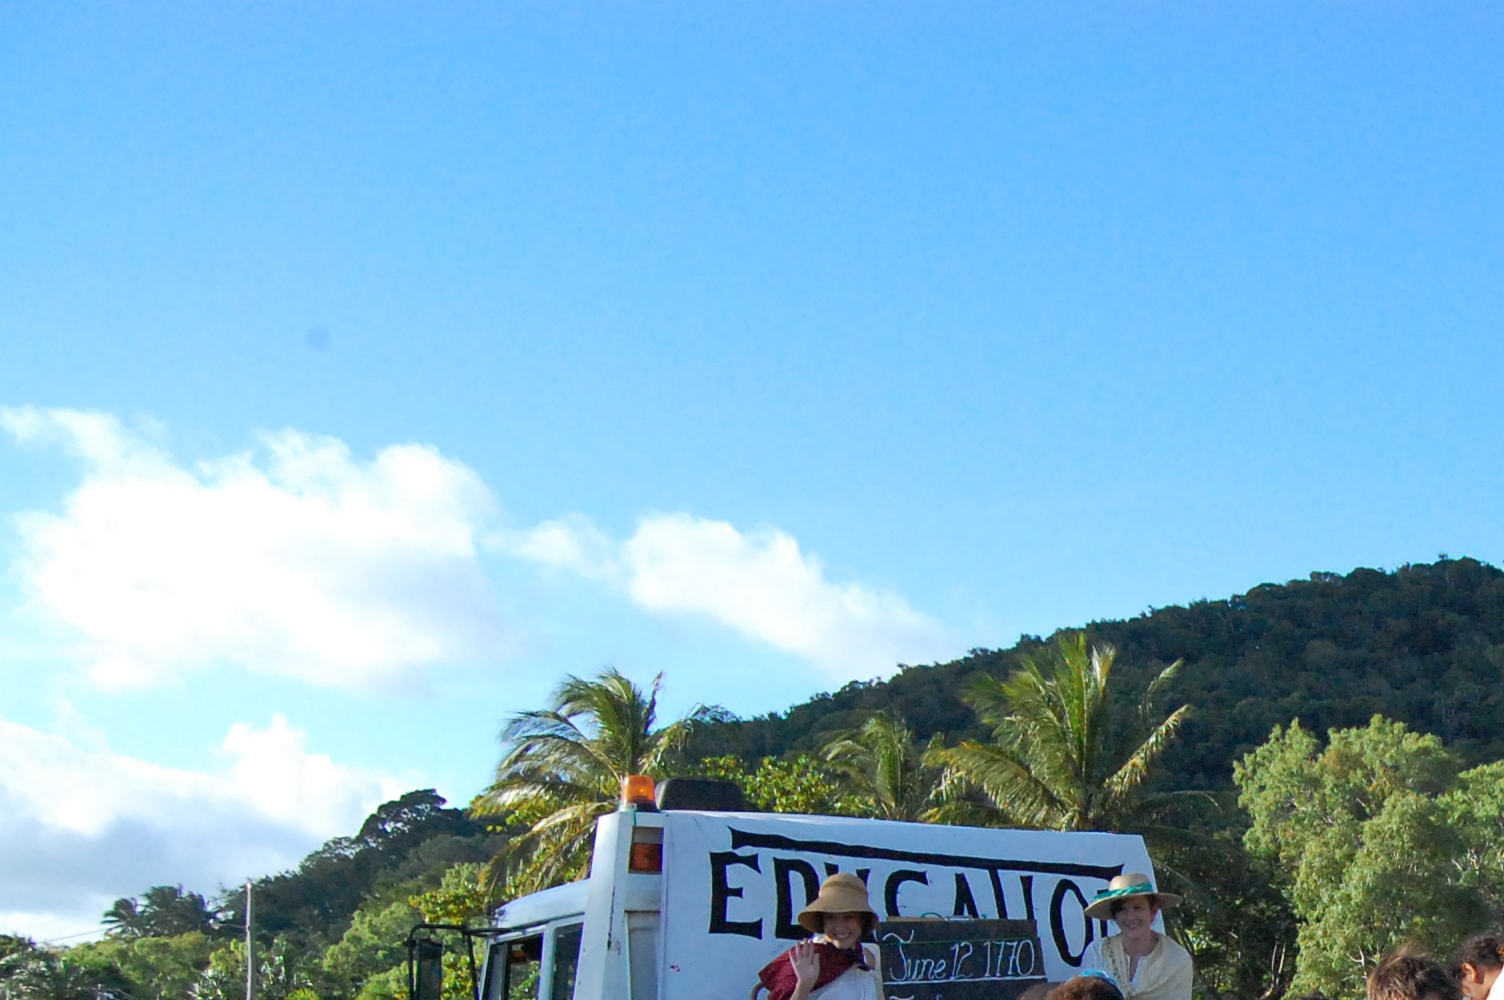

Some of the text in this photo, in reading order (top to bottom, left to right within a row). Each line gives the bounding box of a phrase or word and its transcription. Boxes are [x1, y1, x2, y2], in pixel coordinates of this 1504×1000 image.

[882, 929, 1035, 981] June 12 1770
